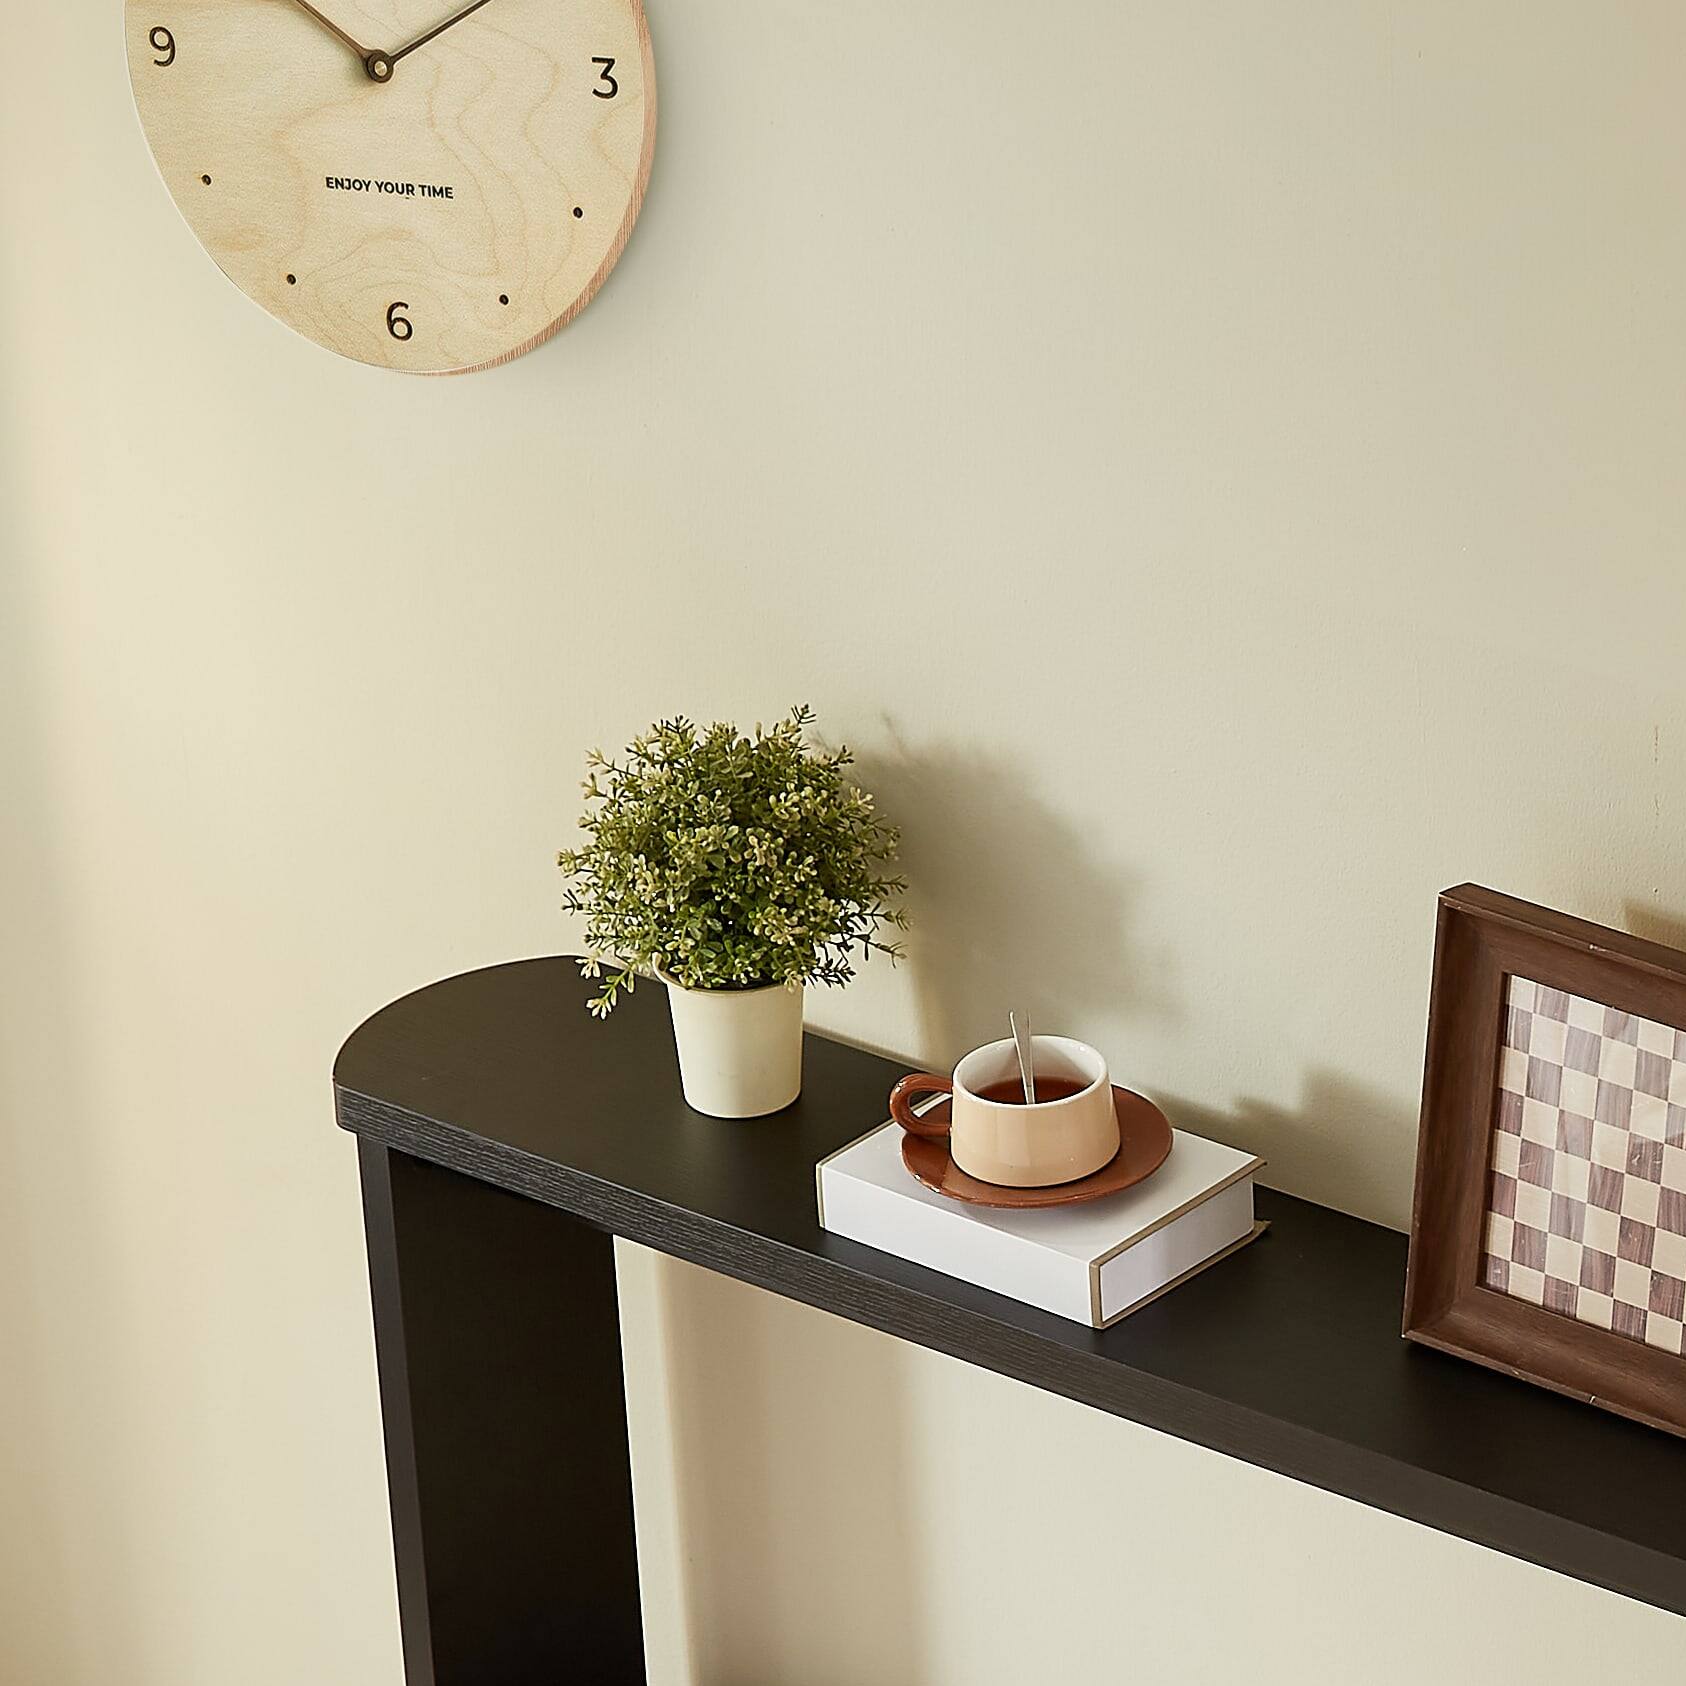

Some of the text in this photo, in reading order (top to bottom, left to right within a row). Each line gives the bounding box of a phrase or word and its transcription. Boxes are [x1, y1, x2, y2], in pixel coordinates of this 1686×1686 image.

[149, 27, 175, 67] 9
[592, 57, 619, 99] 3
[325, 176, 454, 199] ENJOY YOUR TIME
[386, 302, 413, 341] 6
